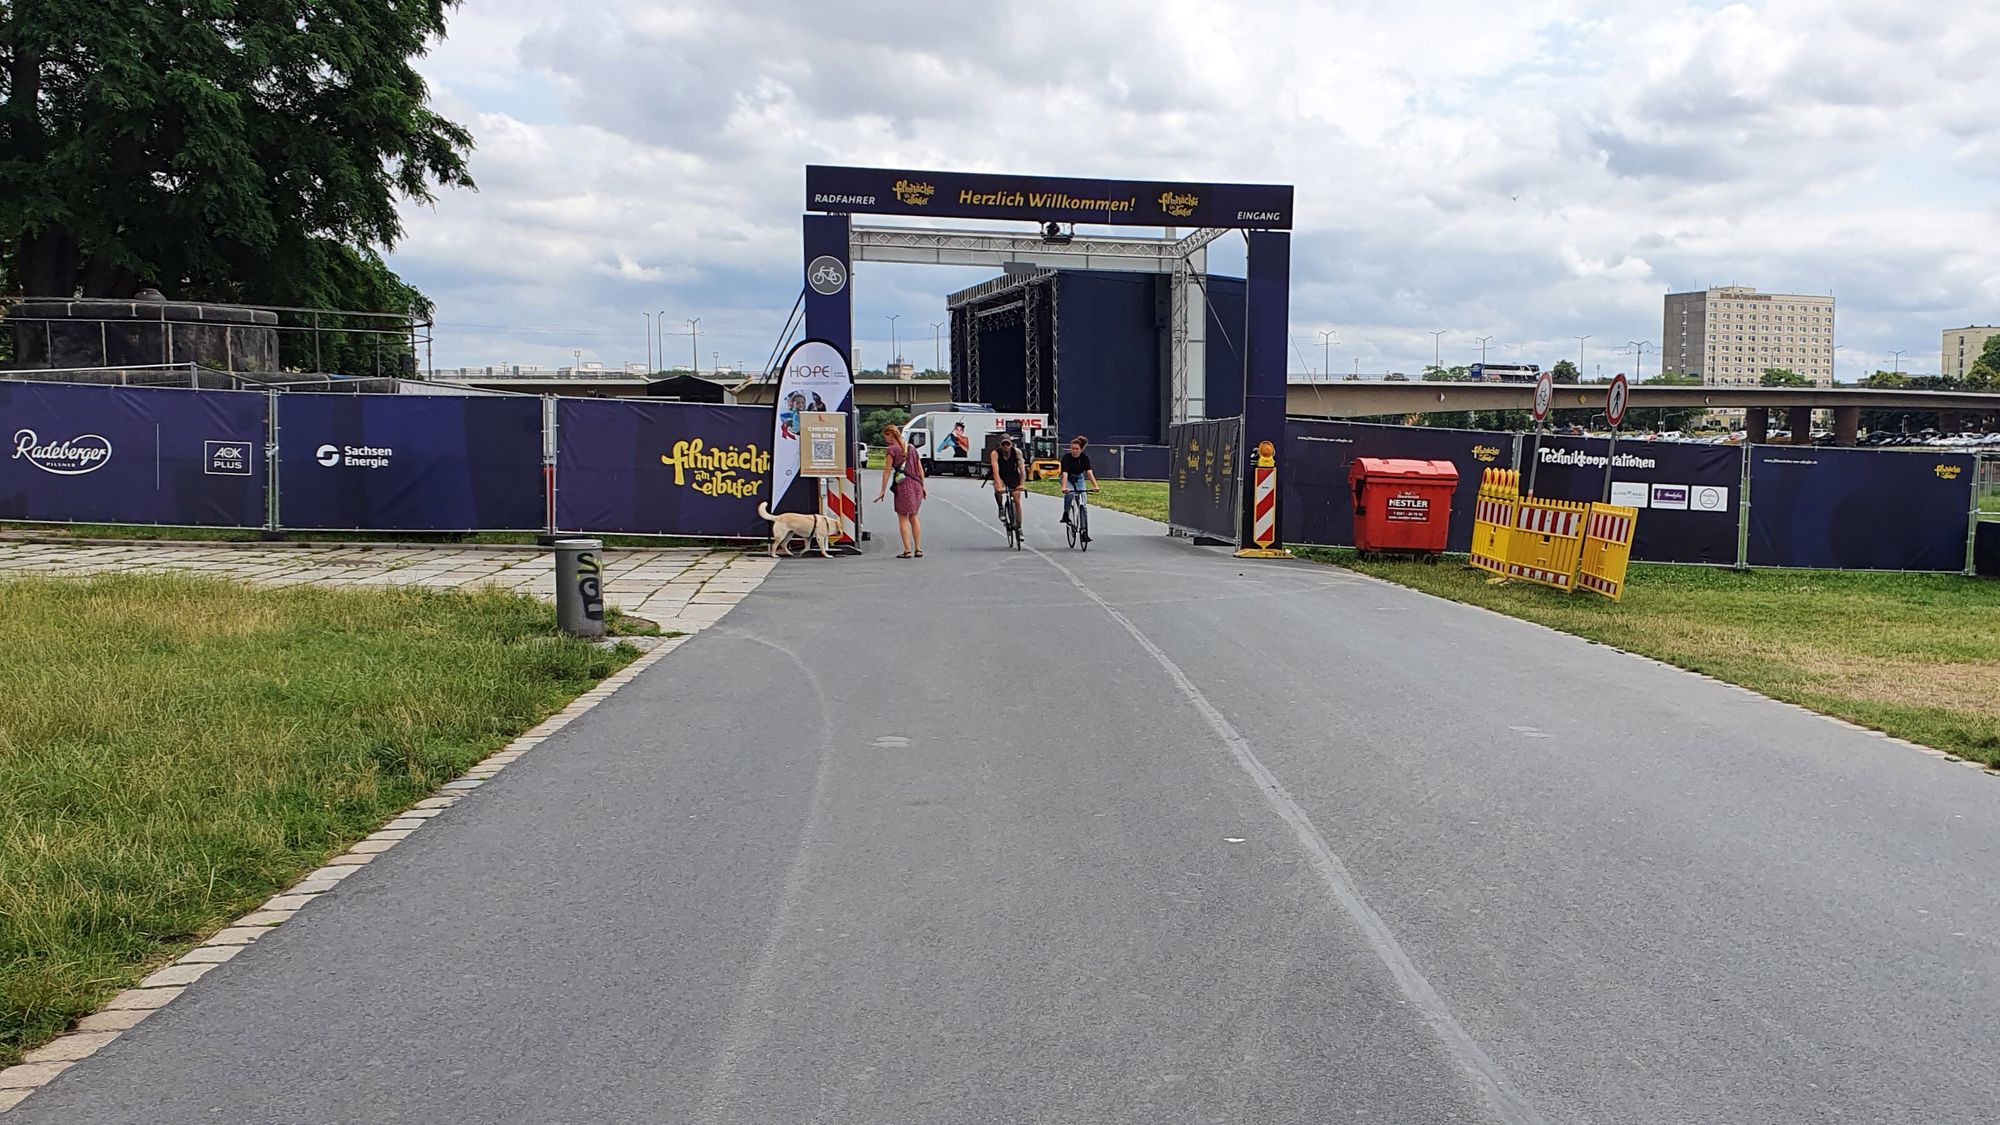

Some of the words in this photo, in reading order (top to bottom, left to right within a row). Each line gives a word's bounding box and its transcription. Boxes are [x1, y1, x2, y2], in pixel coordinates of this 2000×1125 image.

[814, 193, 876, 205] RADFAHRER
[959, 189, 1024, 207] Herzlich
[1029, 192, 1136, 212] Willkommen!
[1237, 211, 1280, 221] EINGANG
[789, 365, 830, 378] HOPE
[12, 429, 107, 466] Radeberger
[213, 446, 243, 459] AOK
[344, 445, 392, 456] Sachsen
[213, 460, 243, 470] PLUS
[344, 456, 389, 469] Energie
[661, 438, 771, 486] filmnächt
[694, 470, 710, 481] am
[691, 470, 762, 498] elbufer
[1388, 499, 1428, 508] NESTLER
